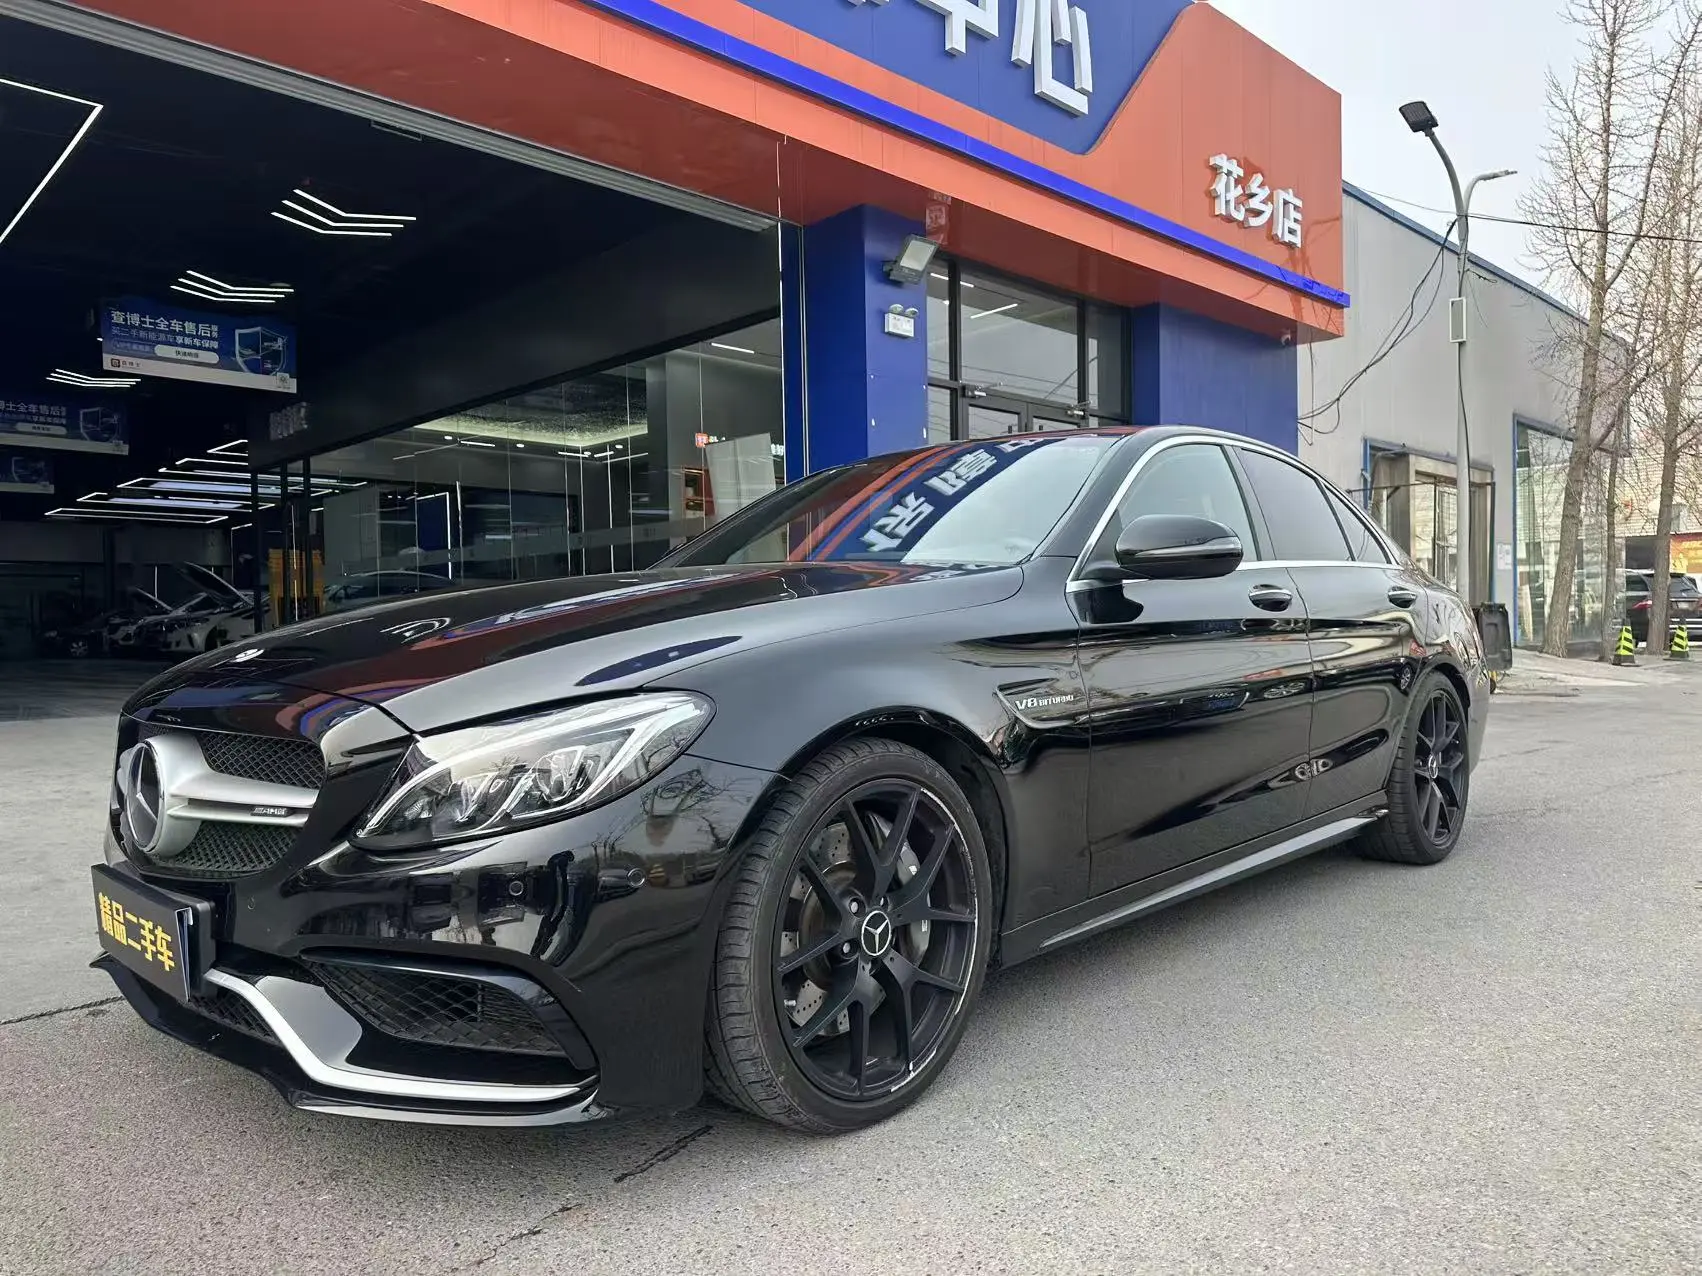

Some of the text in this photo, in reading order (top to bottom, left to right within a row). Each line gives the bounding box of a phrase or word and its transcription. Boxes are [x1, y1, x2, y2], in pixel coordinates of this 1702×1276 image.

[1209, 152, 1303, 249] 花乡店
[1015, 697, 1038, 711] V8
[99, 892, 175, 971] 精品二手车
